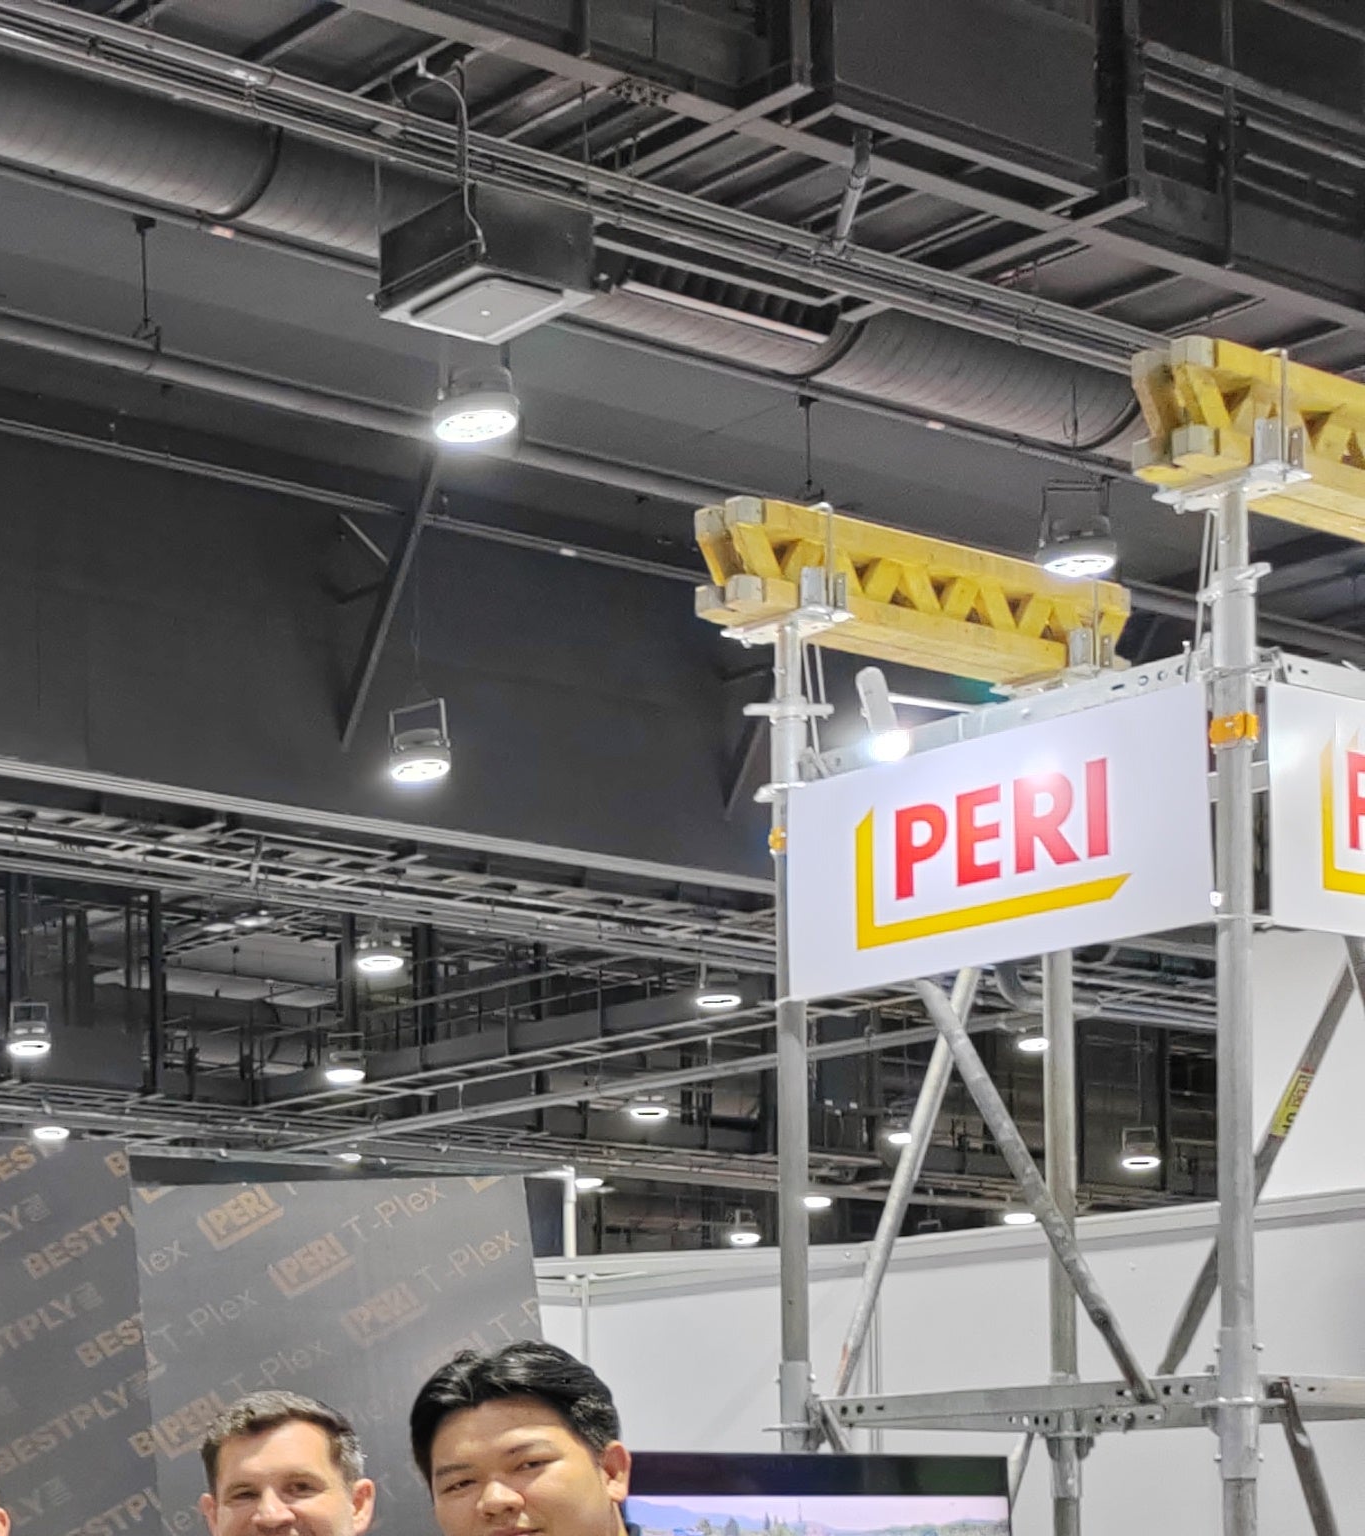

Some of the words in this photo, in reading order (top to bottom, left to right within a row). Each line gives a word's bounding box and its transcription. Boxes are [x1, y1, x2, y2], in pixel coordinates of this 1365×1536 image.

[895, 757, 1110, 901] PERI
[205, 1183, 277, 1237] PERI
[273, 1232, 349, 1287] PERI
[342, 1181, 446, 1243] T-Plex
[415, 1230, 520, 1294] T-Plex
[151, 1290, 258, 1354] T-Plex
